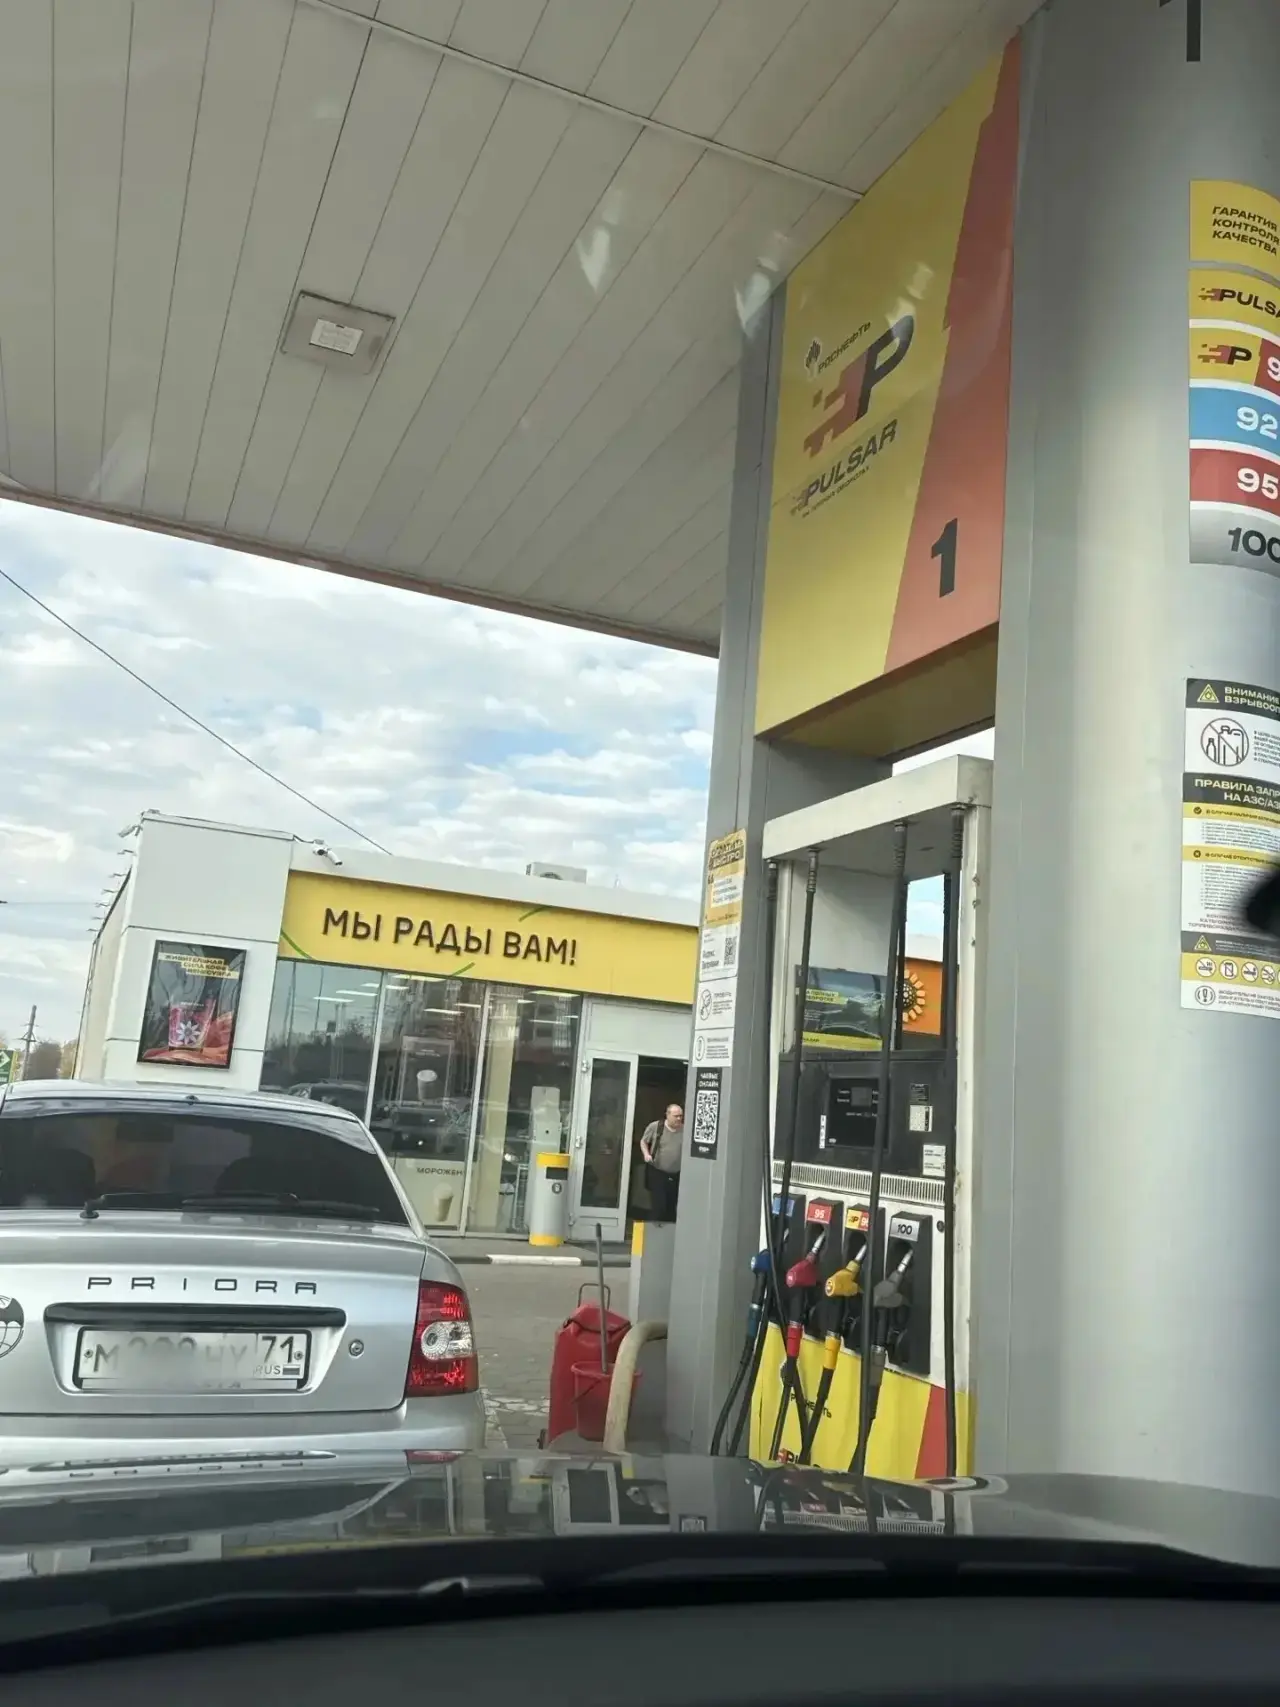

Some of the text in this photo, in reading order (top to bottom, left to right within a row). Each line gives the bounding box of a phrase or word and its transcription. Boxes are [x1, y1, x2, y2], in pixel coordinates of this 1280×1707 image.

[1212, 206, 1278, 233] ГАРАНТИЯ
[1212, 218, 1280, 246] КОНТРОЛЯ
[1212, 230, 1278, 256] КАЧЕСТВА
[818, 321, 872, 374] РОСНЕФТЬ
[1236, 406, 1279, 440] 92
[804, 417, 898, 508] PULSAR
[1237, 467, 1280, 501] 95
[930, 517, 958, 598] 1
[1194, 778, 1255, 793] ПРАВИЛА
[1223, 791, 1280, 811] НА АЗС/АЗ
[322, 907, 578, 966] МЫ РАДЫ ВАМ!
[814, 1208, 825, 1219] 95
[896, 1224, 913, 1235] 100
[87, 1276, 317, 1295] PRIORA
[261, 1335, 294, 1364] 71
